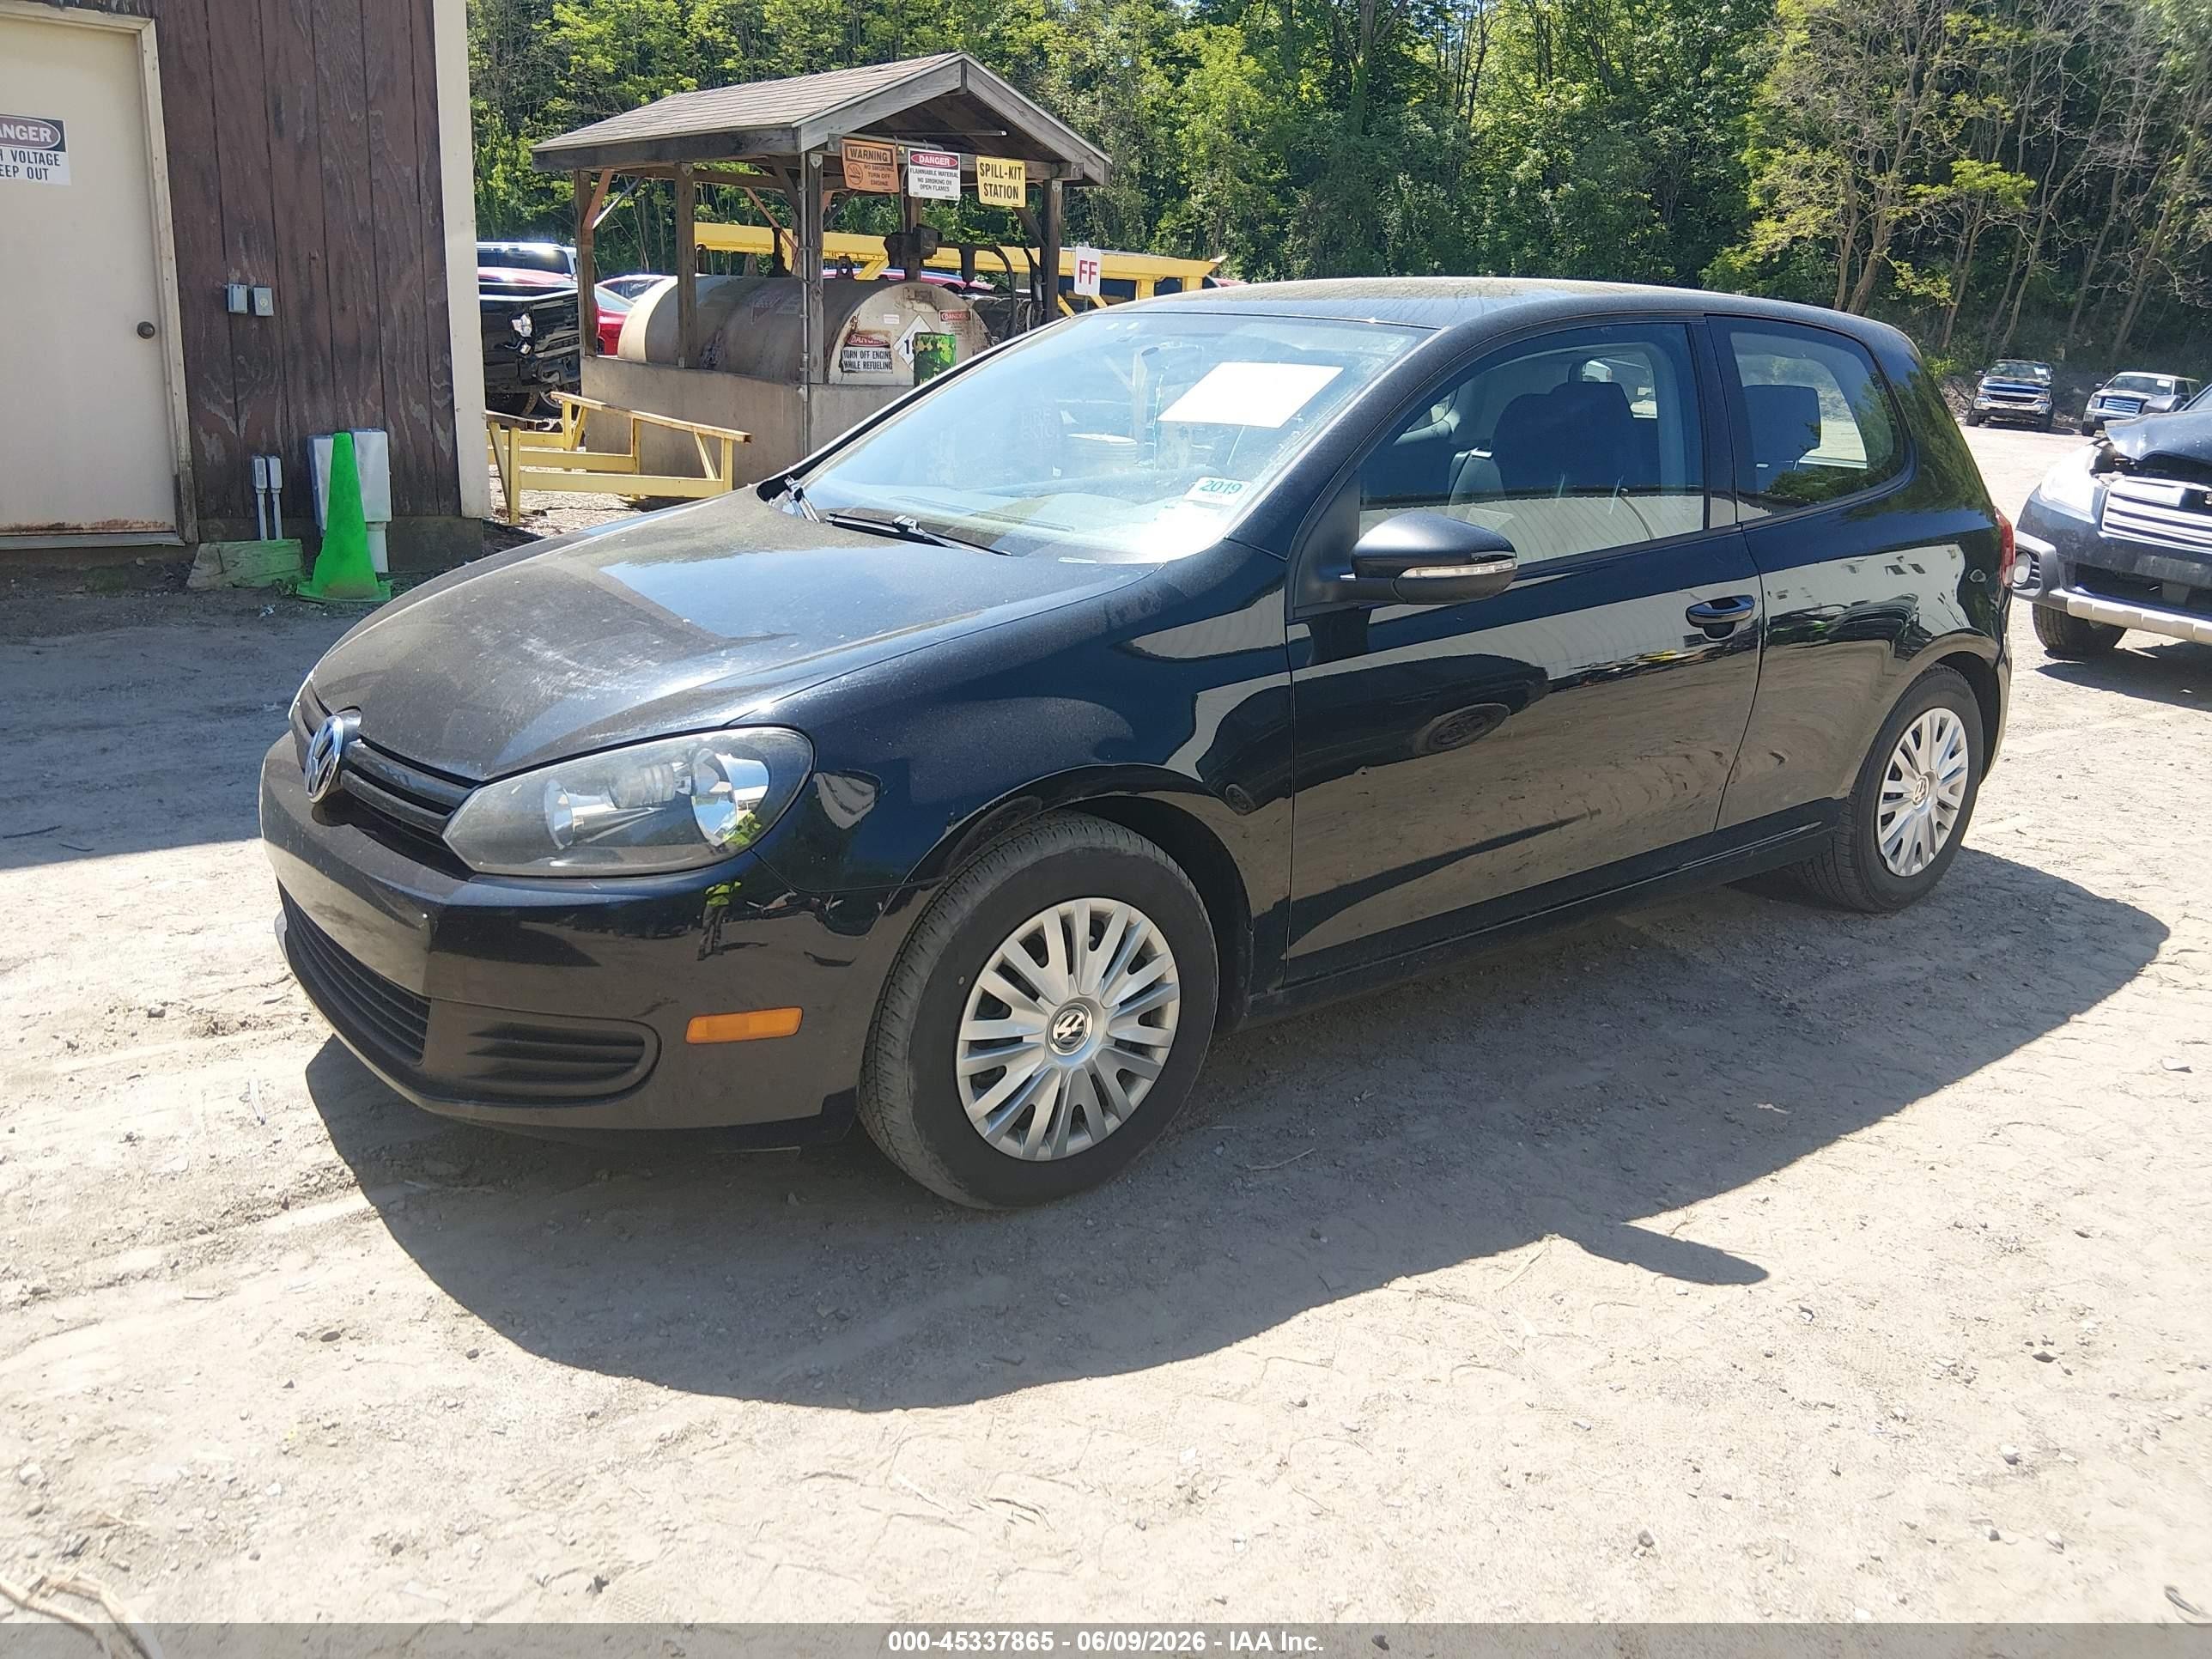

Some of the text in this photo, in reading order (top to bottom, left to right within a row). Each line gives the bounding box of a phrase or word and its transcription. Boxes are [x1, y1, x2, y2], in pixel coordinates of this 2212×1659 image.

[0, 123, 52, 143] NGER
[10, 149, 61, 167] VOLTAGE
[849, 147, 889, 162] WARNING
[919, 155, 950, 166] DANGER
[27, 166, 49, 181] OUT
[910, 167, 959, 179] FLAMMABLE MATERIAL
[979, 162, 1023, 180] SPILL-KIT
[925, 177, 945, 185] SMOKING
[983, 182, 1019, 200] STATION
[1079, 259, 1097, 285] FF
[843, 349, 858, 359] TURN
[860, 350, 870, 360] OFF
[843, 360, 860, 369] WHILE
[1199, 480, 1243, 495] 2019
